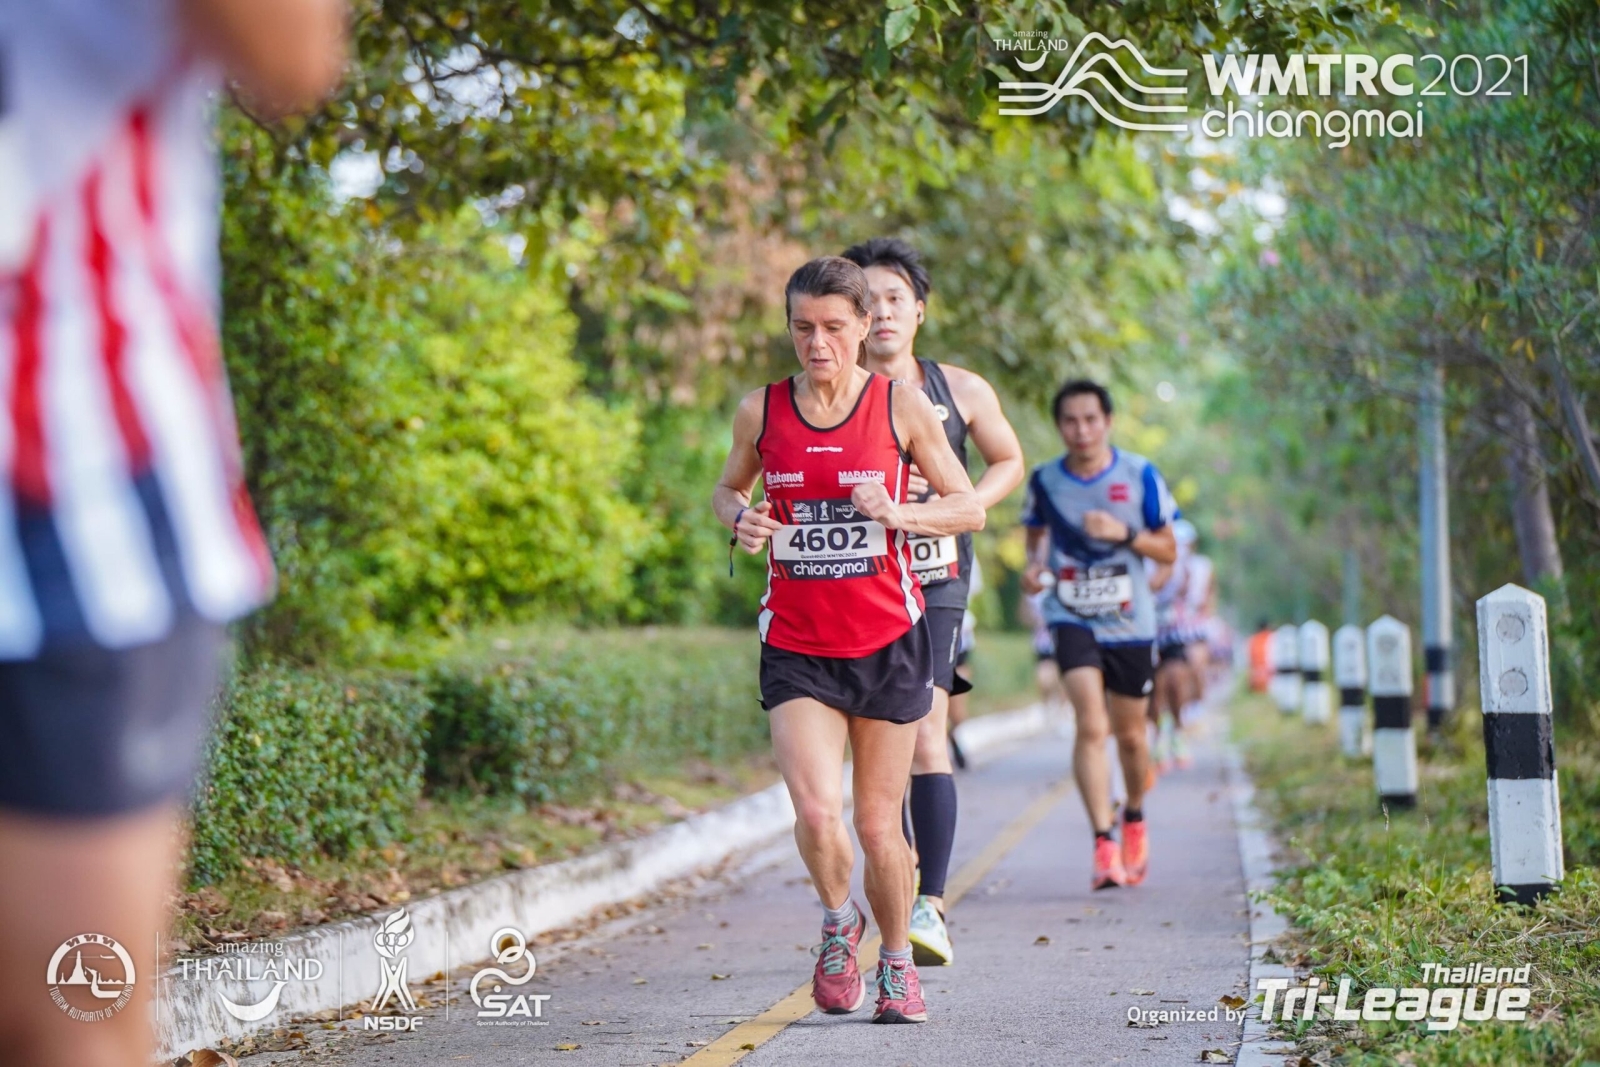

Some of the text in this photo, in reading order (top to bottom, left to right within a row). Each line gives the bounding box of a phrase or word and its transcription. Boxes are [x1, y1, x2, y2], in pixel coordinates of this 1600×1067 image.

[838, 470, 885, 479] MARATON
[789, 526, 868, 552] 4602
[793, 559, 868, 579] chiangmai
